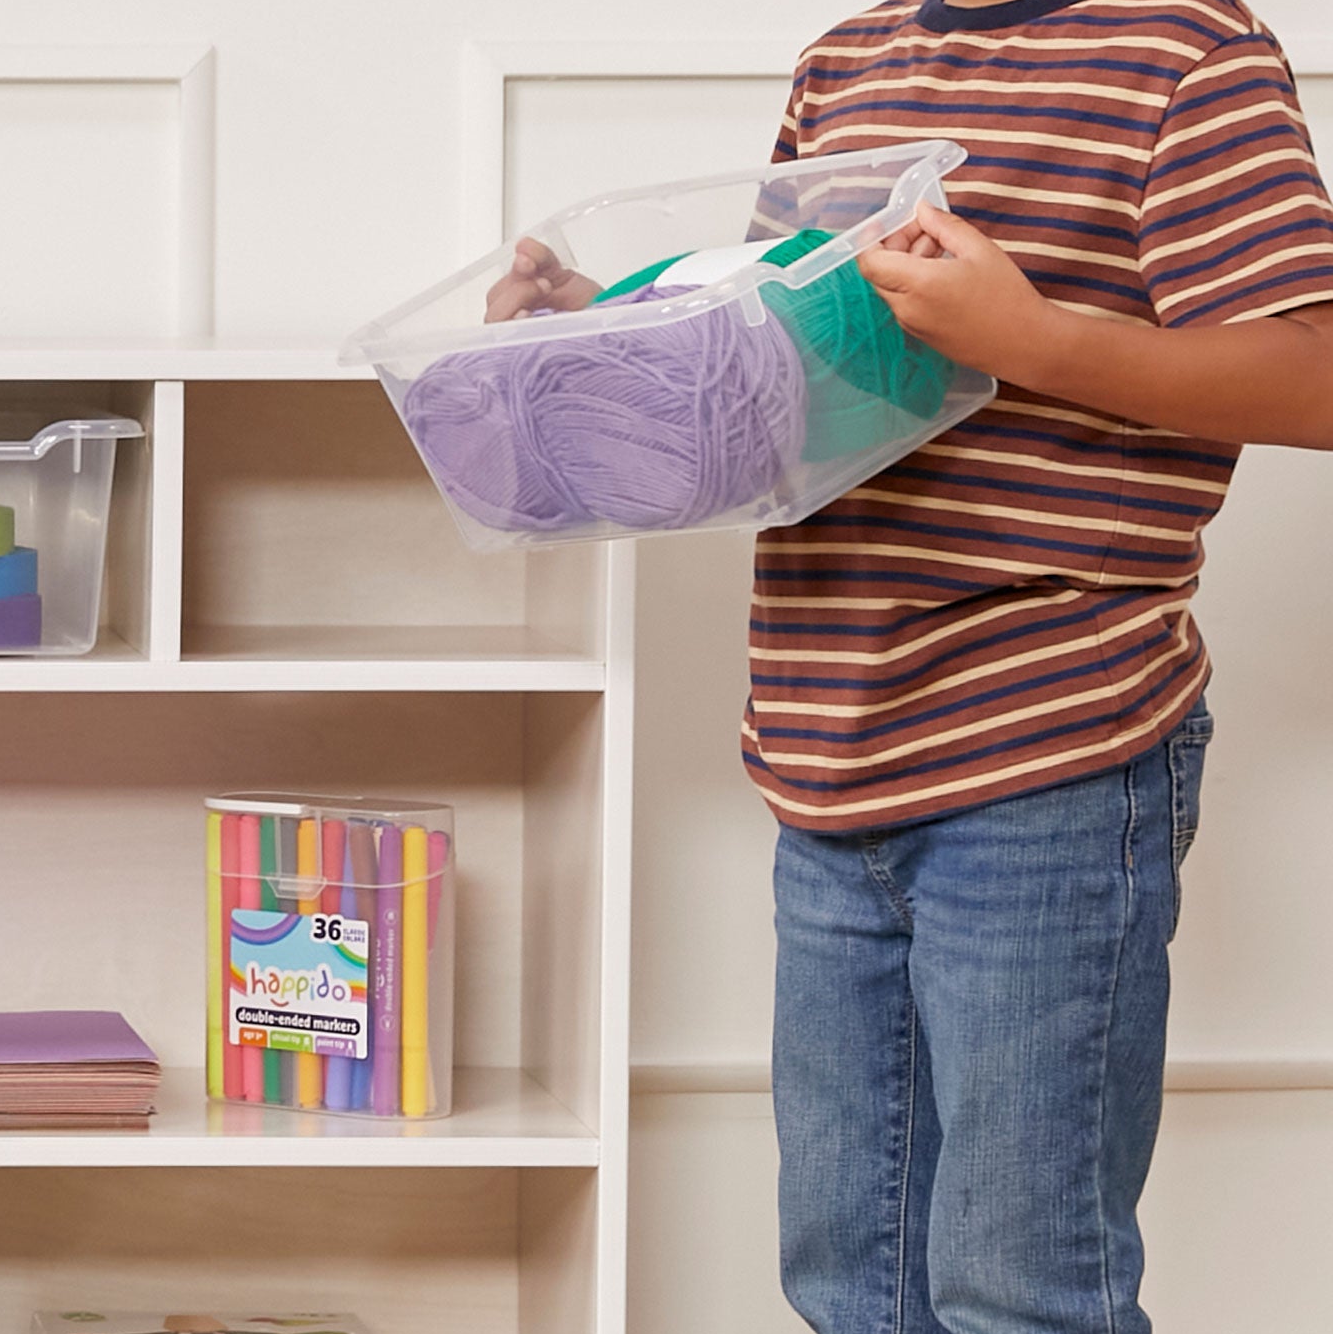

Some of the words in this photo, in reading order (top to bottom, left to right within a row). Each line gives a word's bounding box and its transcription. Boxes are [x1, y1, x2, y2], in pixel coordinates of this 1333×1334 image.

[313, 918, 341, 941] 36
[251, 967, 346, 1002] happido
[238, 1008, 311, 1028] double-ended
[313, 1018, 357, 1033] markers
